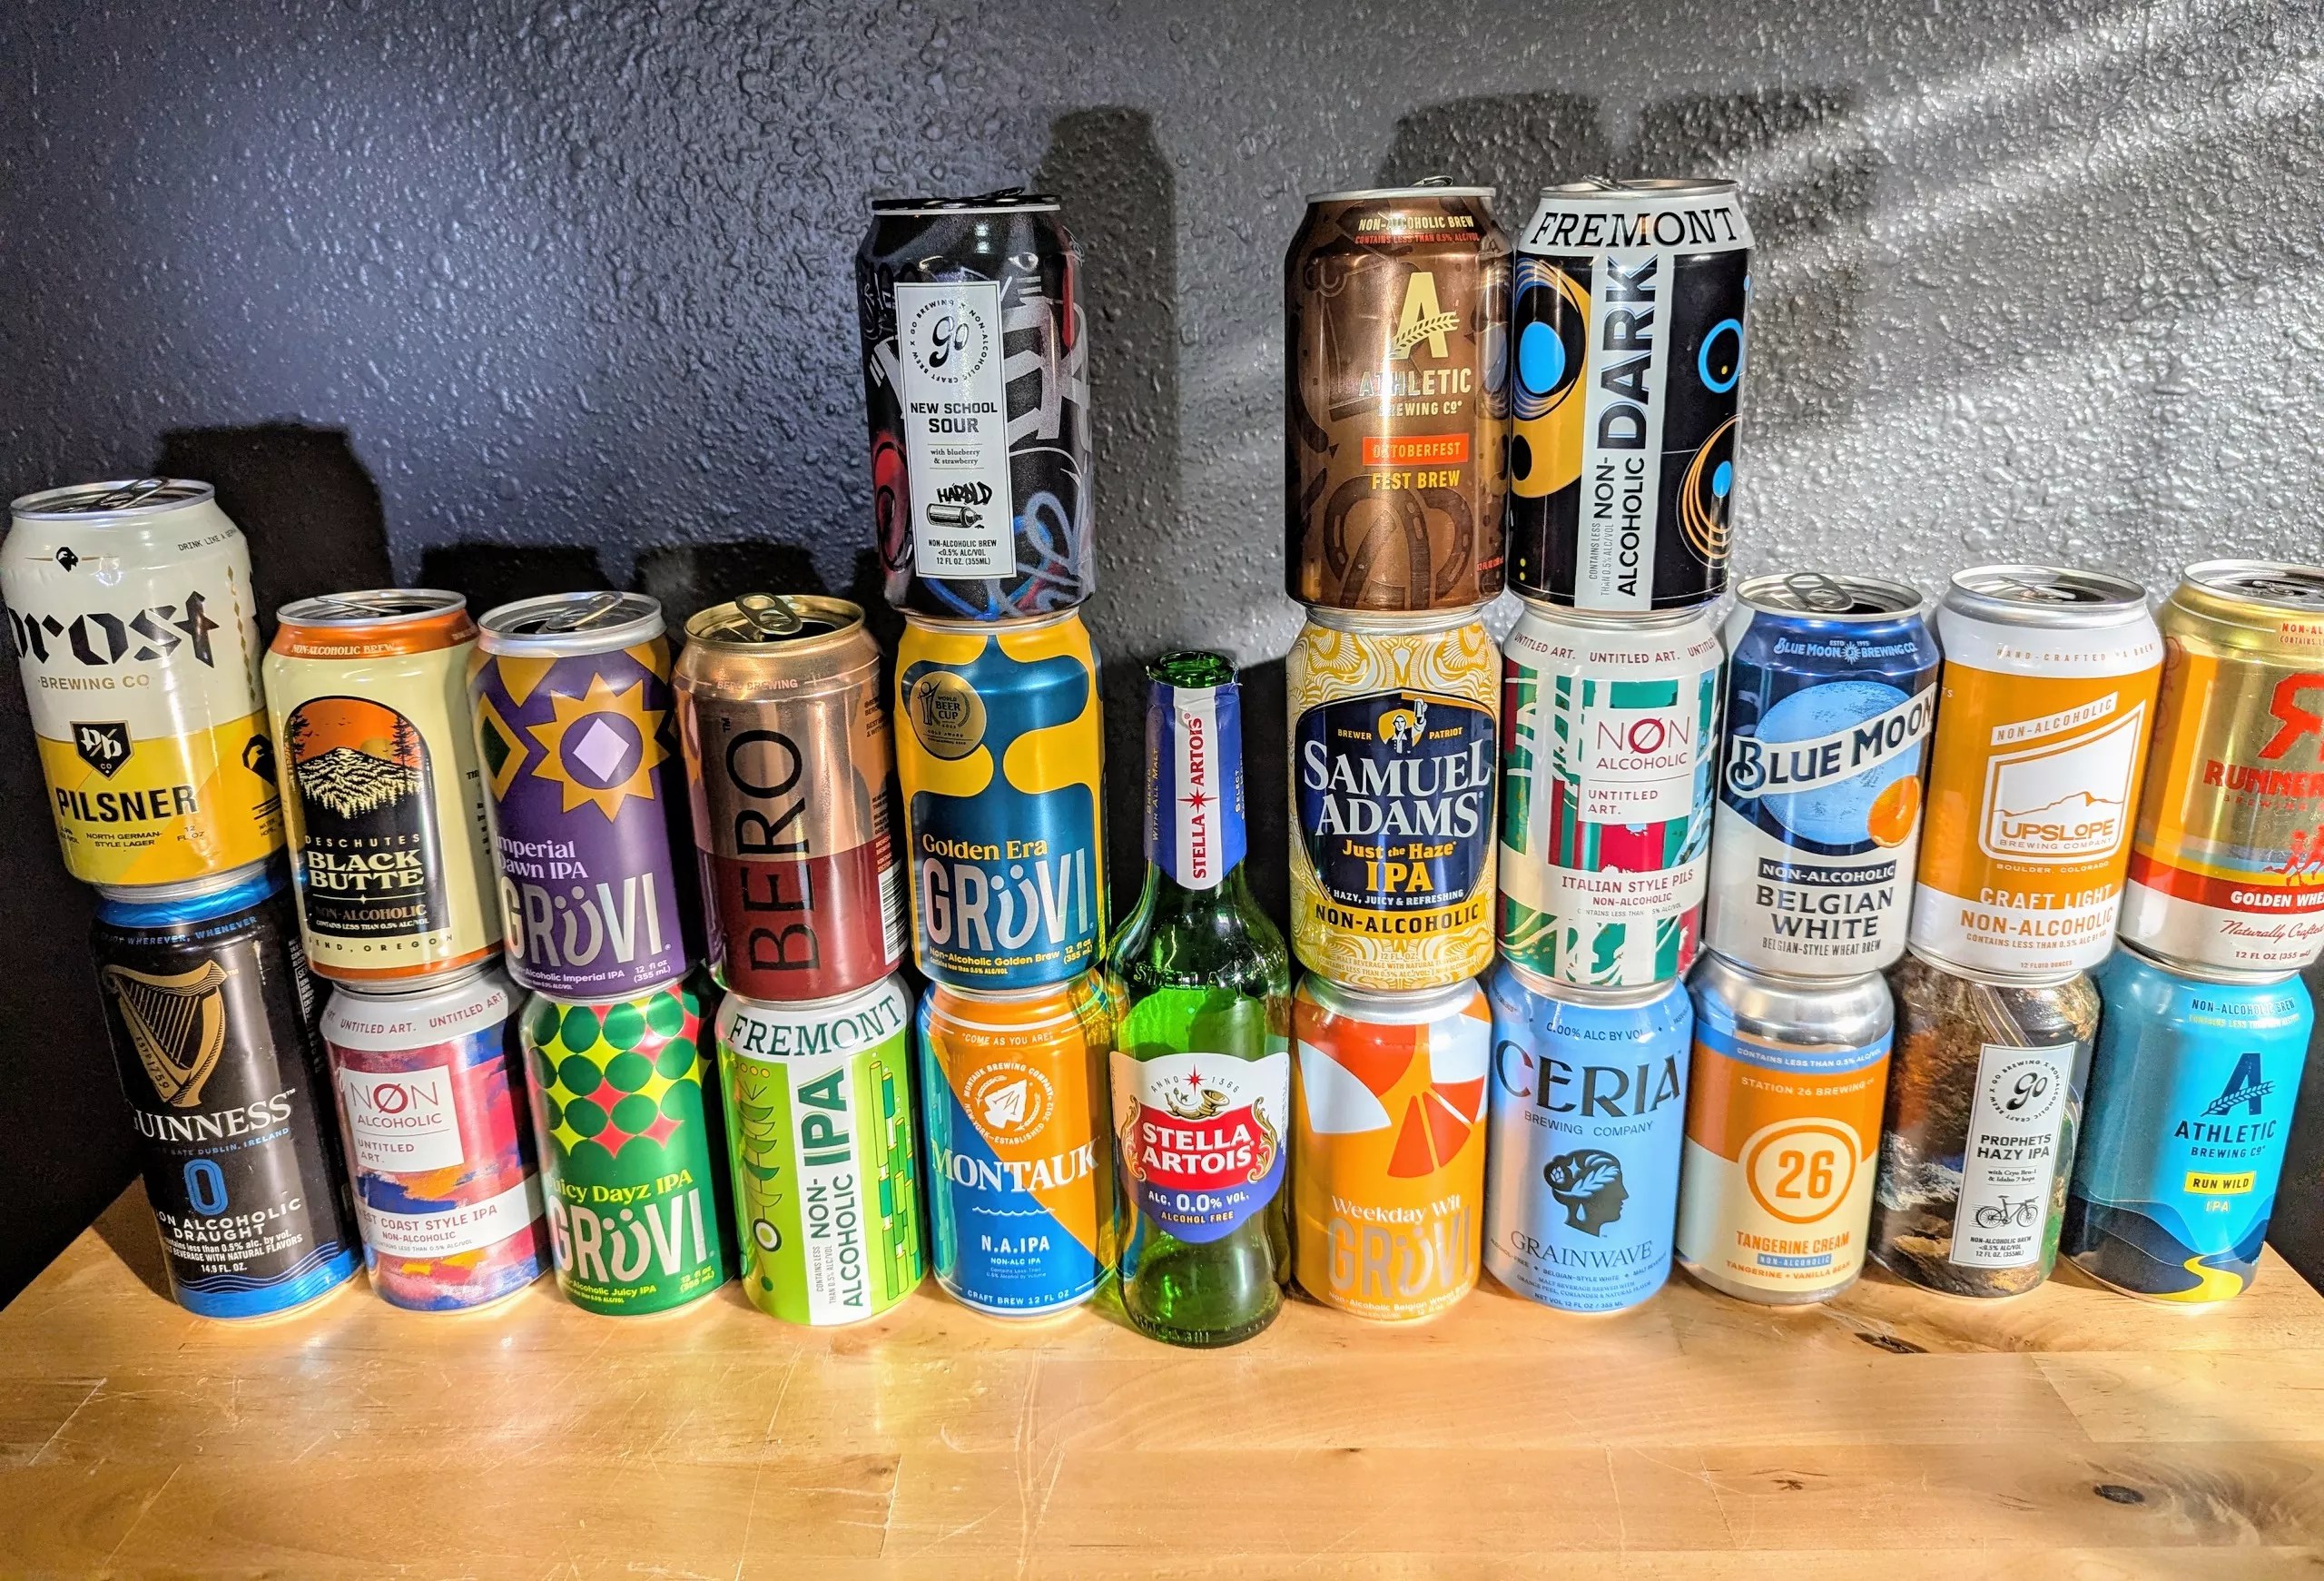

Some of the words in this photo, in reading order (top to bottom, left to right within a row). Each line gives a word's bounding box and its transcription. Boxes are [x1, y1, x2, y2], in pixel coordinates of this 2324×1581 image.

[1358, 215, 1446, 231] NON-ALCOHOLIC
[1448, 215, 1474, 230] BREW
[1530, 205, 1741, 249] FREMONT
[1596, 253, 1659, 450] DARK
[1358, 367, 1472, 397] ATHLETIC
[910, 401, 940, 414] NEW
[944, 400, 999, 414] SCHOOL
[929, 417, 980, 434] SOUR
[930, 448, 945, 457] with
[946, 448, 980, 459] blueberry
[1373, 440, 1462, 459] OKTOBERFEST
[1372, 471, 1412, 491] FEST
[1417, 469, 1461, 490] BREW
[1592, 457, 1615, 520] NON-
[1618, 456, 1645, 598] ALCOHOLIC
[928, 539, 975, 548] NON-ALCOHOLIC
[976, 539, 998, 547] BREW
[938, 548, 959, 558] <0.5%
[960, 548, 987, 558] ALC/VOL
[292, 643, 361, 657] NON-ALCOHOLIC
[363, 642, 396, 654] BREW
[1514, 632, 1549, 654] UNTITLED
[1550, 645, 1576, 660] ART.
[1589, 652, 1649, 664] UNTITLED
[1654, 651, 1680, 663] ART.
[935, 701, 960, 712] BEER
[938, 711, 959, 721] CUP
[1996, 697, 2113, 742] NON-ALCOHOLIC
[1337, 728, 1373, 740] BREWER
[1429, 726, 1463, 740] PATRIOT
[1189, 716, 1205, 786] ARTOIS
[1596, 752, 1689, 771] ALCOHOLIC
[1304, 738, 1492, 798] SAMUEL
[1726, 739, 1844, 793] BLUE
[55, 785, 198, 824] PILSNER
[1588, 790, 1659, 802] UNTITLED
[1315, 791, 1479, 838] ADAMS
[1588, 804, 1622, 815] ART.
[305, 833, 420, 848] DESCHUTES
[2001, 818, 2115, 843] UPSLOPE
[725, 728, 821, 972] BERO
[922, 833, 1000, 861] Golden
[1006, 838, 1048, 859] Era
[1192, 812, 1206, 879] STELLA
[1343, 839, 1384, 859] Just
[1387, 845, 1405, 856] the
[1407, 841, 1453, 858] Haze
[1999, 839, 2059, 851] BREWING
[2063, 835, 2113, 850] COMPANY
[306, 848, 422, 873] BLACK
[2060, 860, 2110, 874] COLORADO
[310, 868, 424, 890] BUTTE
[1364, 861, 1433, 893] IPA
[1561, 875, 1622, 894] ITALIAN
[1628, 876, 1669, 894] STYLE
[1671, 868, 1694, 888] PILS
[1761, 863, 1896, 884] NON-ALCOHOLIC
[1334, 889, 1363, 904] HAZY,
[1364, 894, 1393, 906] JUICY
[1395, 895, 1403, 906] &
[1405, 888, 1464, 905] REFRESHING
[1592, 892, 1672, 907] NON-ALCOHOLIC
[1756, 884, 1894, 916] BELGIAN
[1978, 886, 2056, 910] CRAFT
[2063, 883, 2113, 909] LIGHT
[2230, 890, 2292, 908] GOLDEN
[315, 904, 428, 922] NON-ALCOHOLIC
[1314, 902, 1479, 934] NON-ALCOHOLIC
[1960, 903, 2114, 938] NON-ALCOHOLIC
[1770, 913, 1880, 941] WHITE
[1762, 936, 1830, 958] BELGIAN-STYLE
[1831, 939, 1860, 957] WHEAT
[1860, 937, 1882, 954] BREW
[1965, 932, 2011, 948] CONTAINS
[2012, 939, 2034, 950] LESS
[2035, 939, 2058, 950] THAN
[2058, 938, 2077, 949] 0.5%
[2078, 934, 2092, 945] ALC
[562, 971, 605, 983] Imperial
[606, 969, 625, 980] IPA
[729, 994, 901, 1057] FREMONT
[1546, 1022, 1581, 1038] 0.00%
[1583, 1030, 1607, 1041] ALC
[1609, 1031, 1624, 1042] BY
[1736, 1046, 1783, 1065] CONTAINS
[1785, 1058, 1807, 1068] LESS
[1809, 1059, 1835, 1068] THAN
[1836, 1057, 1855, 1067] 0.5%
[1150, 1075, 1179, 1092] ANNO
[1211, 1075, 1240, 1092] 1366
[1496, 1039, 1681, 1118] CERIA
[1740, 1076, 1794, 1095] STATION
[1797, 1087, 1812, 1096] 26
[1815, 1080, 1866, 1097] BREWING
[358, 1112, 443, 1129] ALCOHOLIC
[797, 1065, 852, 1168] IPA
[1524, 1110, 1584, 1136] BREWING
[1593, 1120, 1654, 1137] COMPANY
[1142, 1122, 1252, 1151] STELLA
[1980, 1133, 2052, 1147] PROPHETS
[2174, 1119, 2278, 1145] ATHLETIC
[358, 1138, 415, 1153] UNTITLED
[1976, 1146, 2024, 1161] HAZY
[2027, 1145, 2051, 1160] IPA
[2191, 1147, 2246, 1160] BREWING
[360, 1151, 386, 1163] ART.
[931, 1139, 1100, 1195] MONTAUK
[1141, 1145, 1252, 1175] ARTOIS
[1775, 1150, 1836, 1200] 26
[2192, 1178, 2220, 1190] RUN
[2222, 1176, 2250, 1190] WILD
[593, 1181, 652, 1205] Dayz
[656, 1168, 694, 1197] IPA
[183, 1197, 302, 1232] ALCOHOLIC
[380, 1218, 420, 1231] COAST
[425, 1212, 468, 1231] STYLE
[473, 1203, 498, 1221] IPA
[808, 1178, 831, 1240] NON-
[1161, 1211, 1206, 1224] ALCOHOL
[1210, 1210, 1235, 1221] FREE
[1332, 1195, 1426, 1225] Weekday
[1433, 1193, 1462, 1214] Wit
[2205, 1200, 2230, 1214] IPA
[173, 1223, 266, 1243] DRAUGHT
[381, 1230, 457, 1243] NON-ALCOHOLIC
[833, 1172, 863, 1308] ALCOHOLIC
[1736, 1230, 1809, 1255] TANGERINE
[1812, 1230, 1850, 1254] CREAM
[990, 1256, 1025, 1265] NON-ALC
[1028, 1256, 1041, 1265] IPA
[1510, 1230, 1653, 1269] GRAINWAVE
[1759, 1253, 1833, 1267] NON-ALCOHOLIC
[611, 1286, 638, 1299] Juicy
[639, 1283, 657, 1295] IPA
